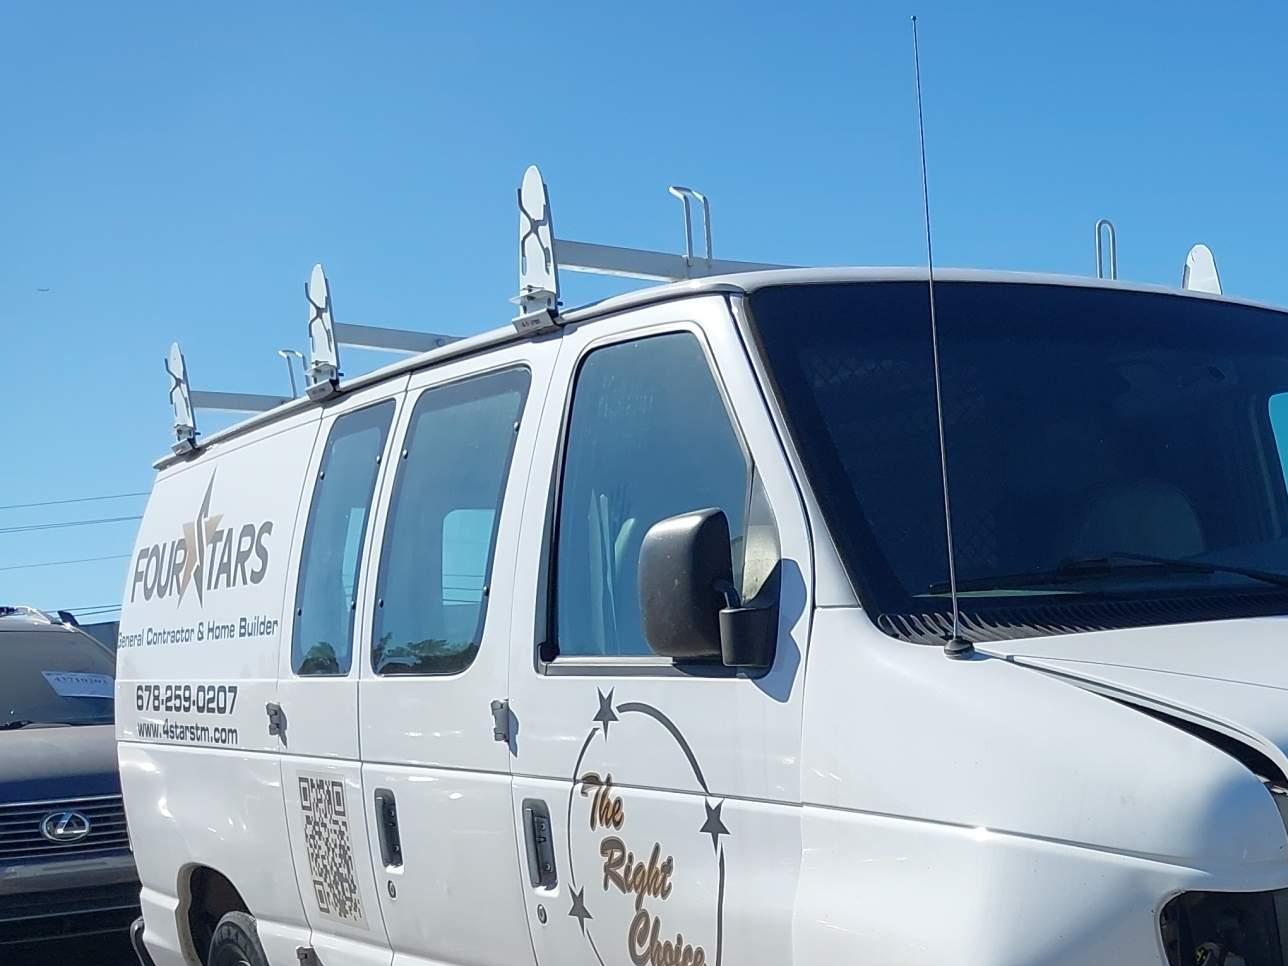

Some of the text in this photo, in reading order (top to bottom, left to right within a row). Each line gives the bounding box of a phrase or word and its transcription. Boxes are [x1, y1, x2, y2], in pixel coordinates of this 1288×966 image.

[118, 616, 278, 649] General Contractor & Home Builder
[136, 685, 238, 714] 678-259-0207
[137, 718, 238, 745] www.4starstm.com
[581, 772, 624, 830] The
[600, 837, 673, 909] Right
